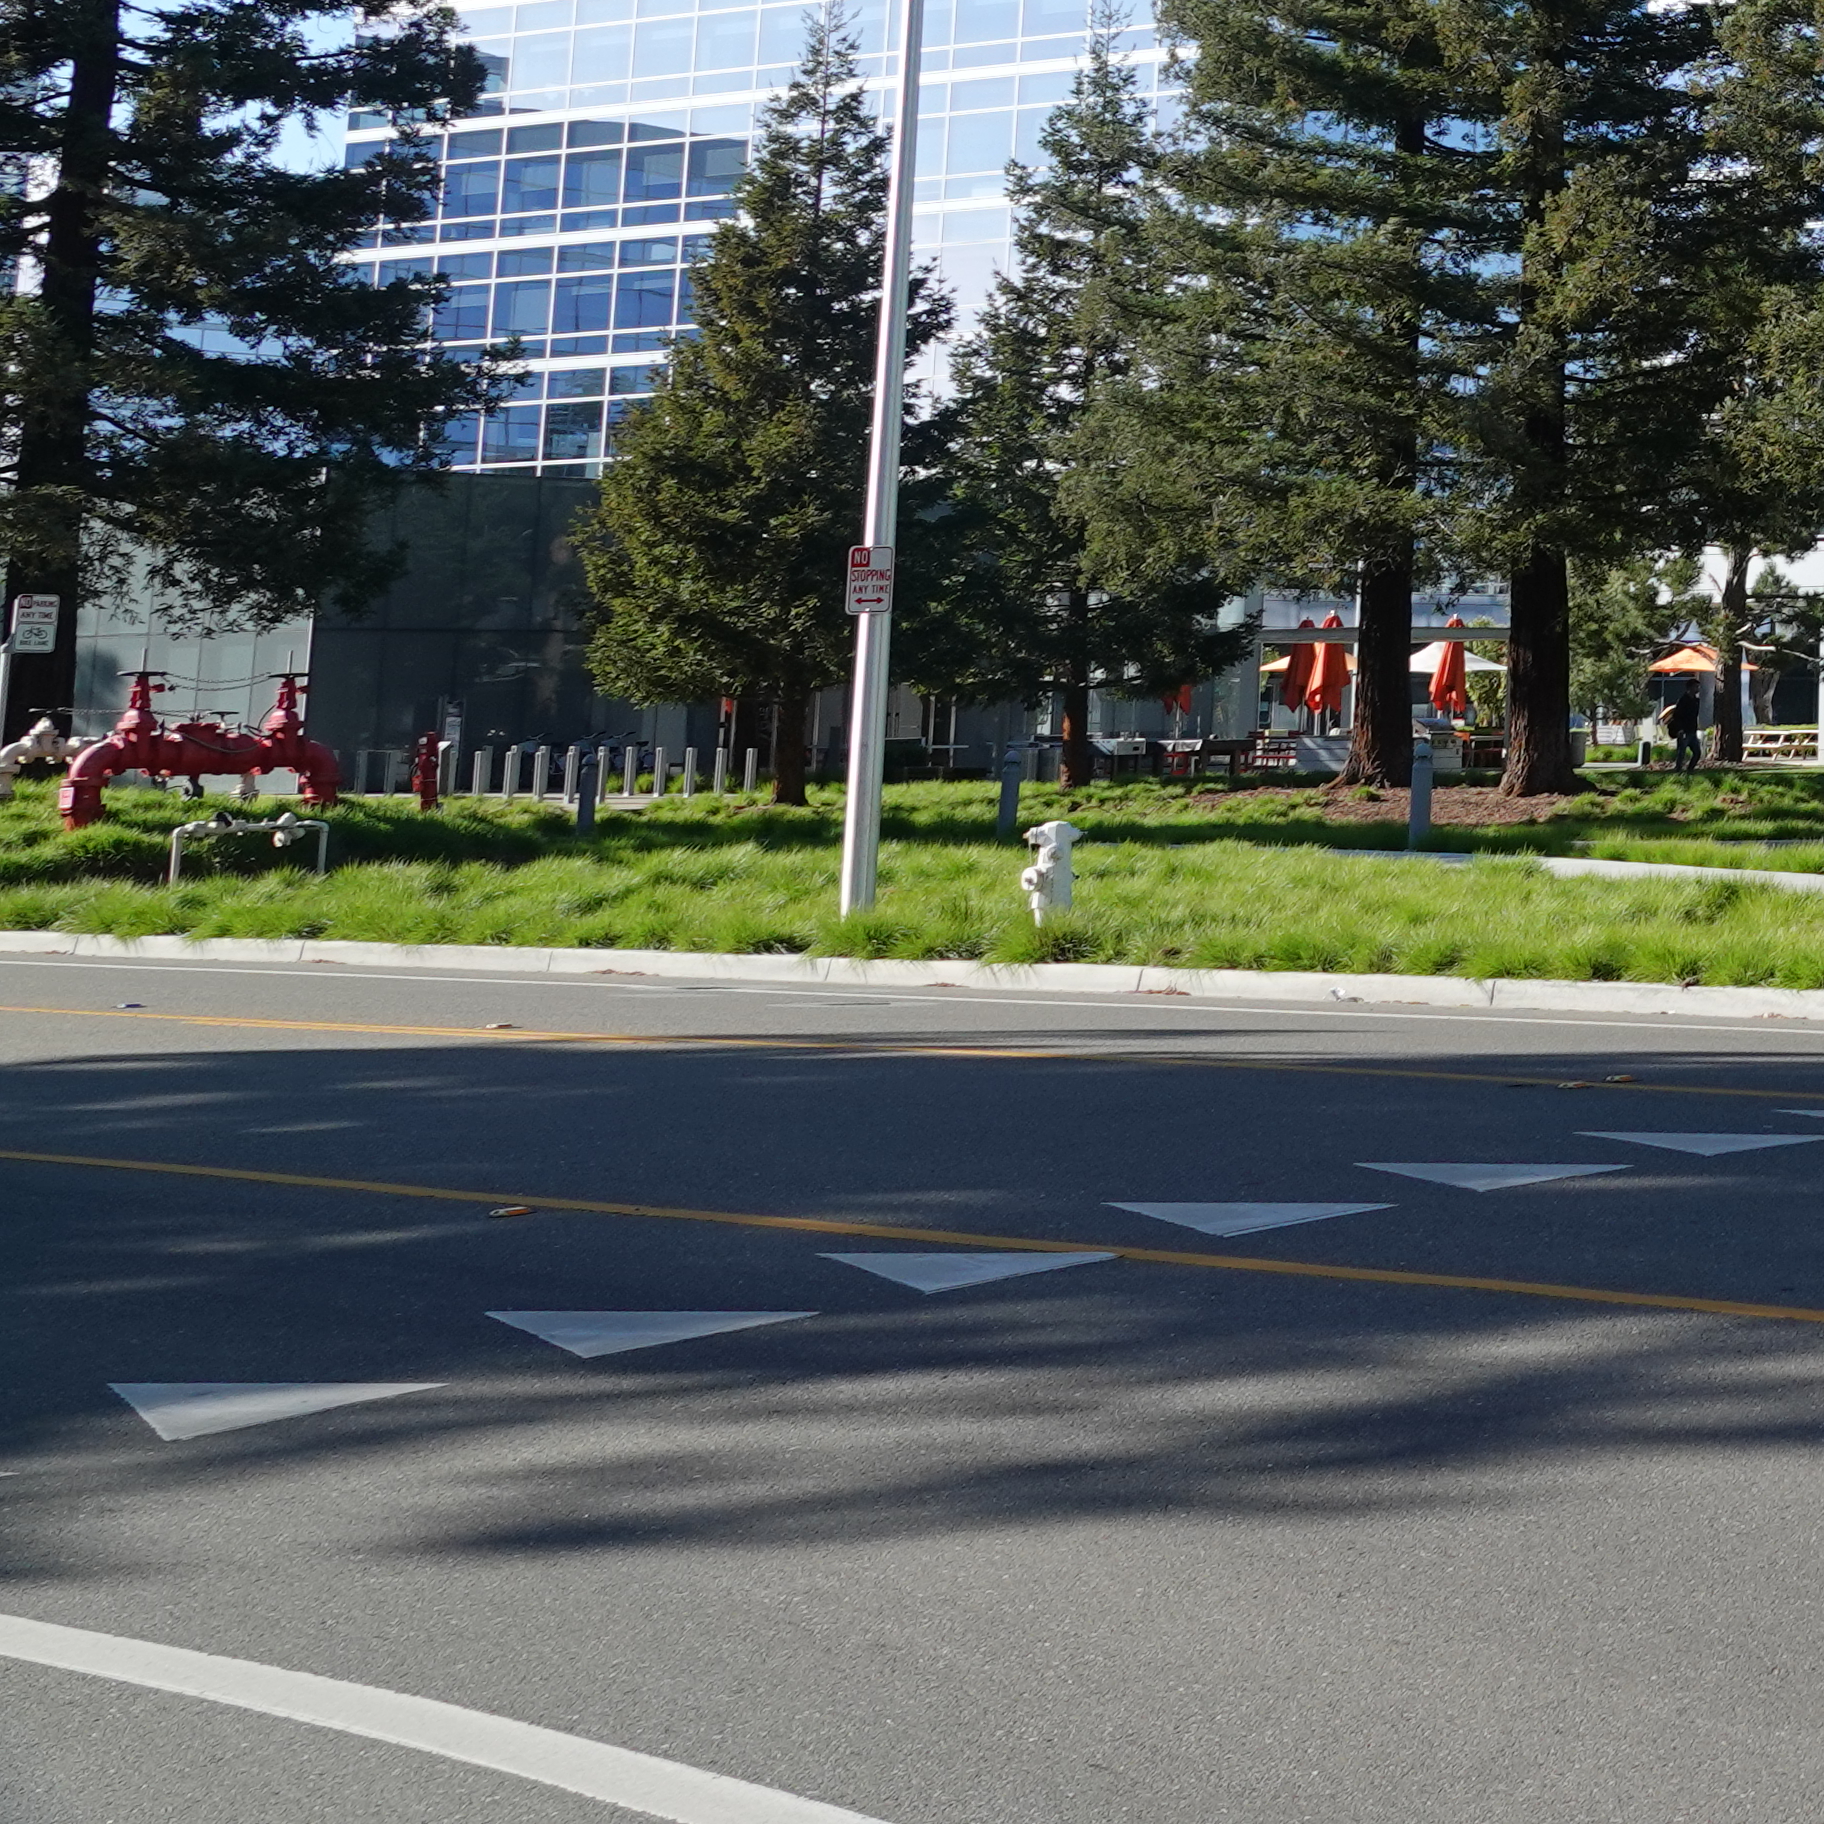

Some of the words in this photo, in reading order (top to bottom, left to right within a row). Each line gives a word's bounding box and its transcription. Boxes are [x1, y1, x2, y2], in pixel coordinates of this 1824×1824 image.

[854, 550, 869, 564] NO
[851, 569, 892, 582] STOPPING
[852, 585, 868, 594] ANY
[872, 584, 889, 594] TIME
